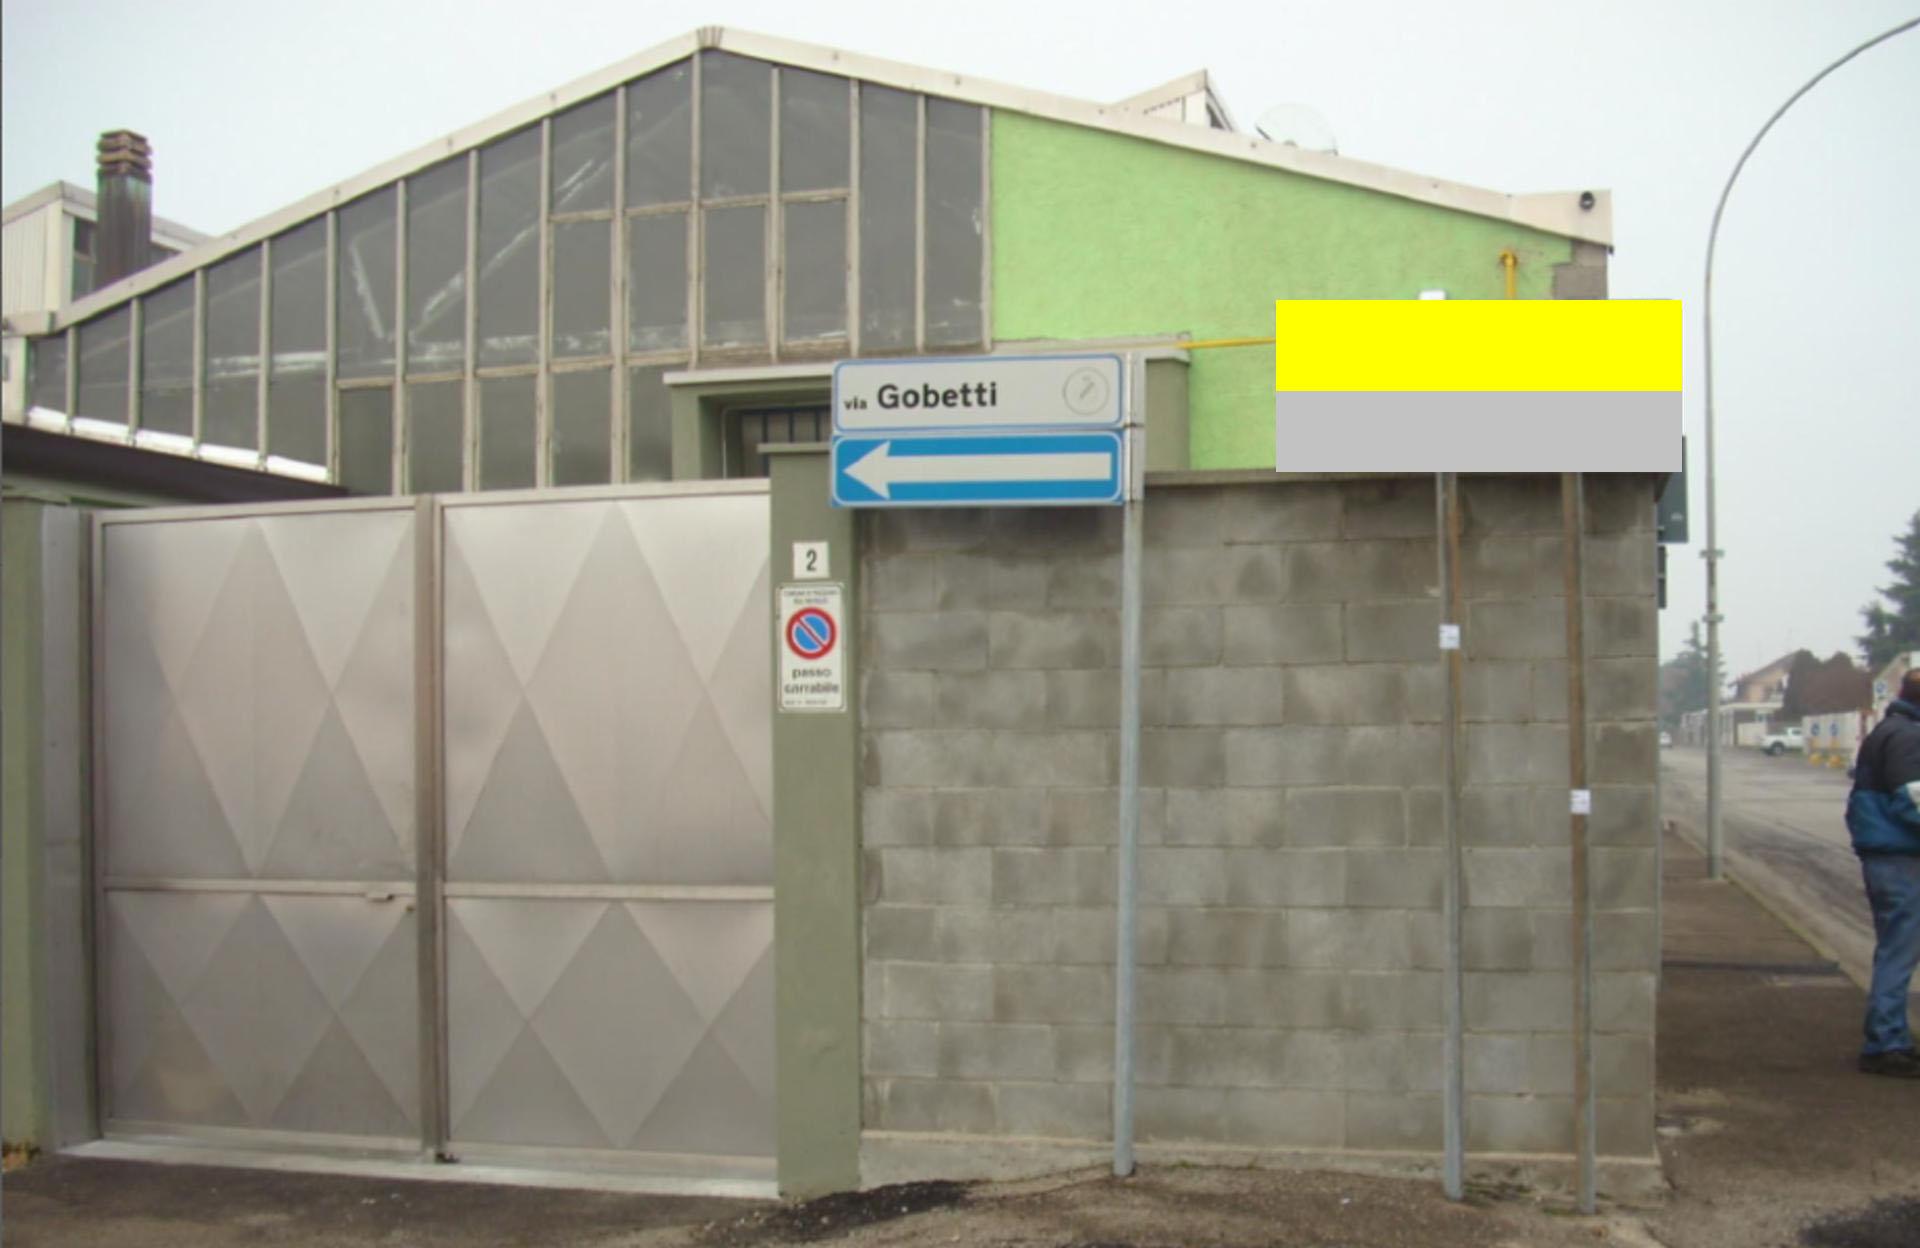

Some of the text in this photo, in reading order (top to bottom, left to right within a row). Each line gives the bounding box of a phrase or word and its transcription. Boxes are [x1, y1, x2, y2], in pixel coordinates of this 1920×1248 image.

[844, 382, 997, 410] via Gobetti
[805, 548, 817, 572] 2
[792, 668, 832, 680] passo
[784, 682, 839, 695] carrabile
